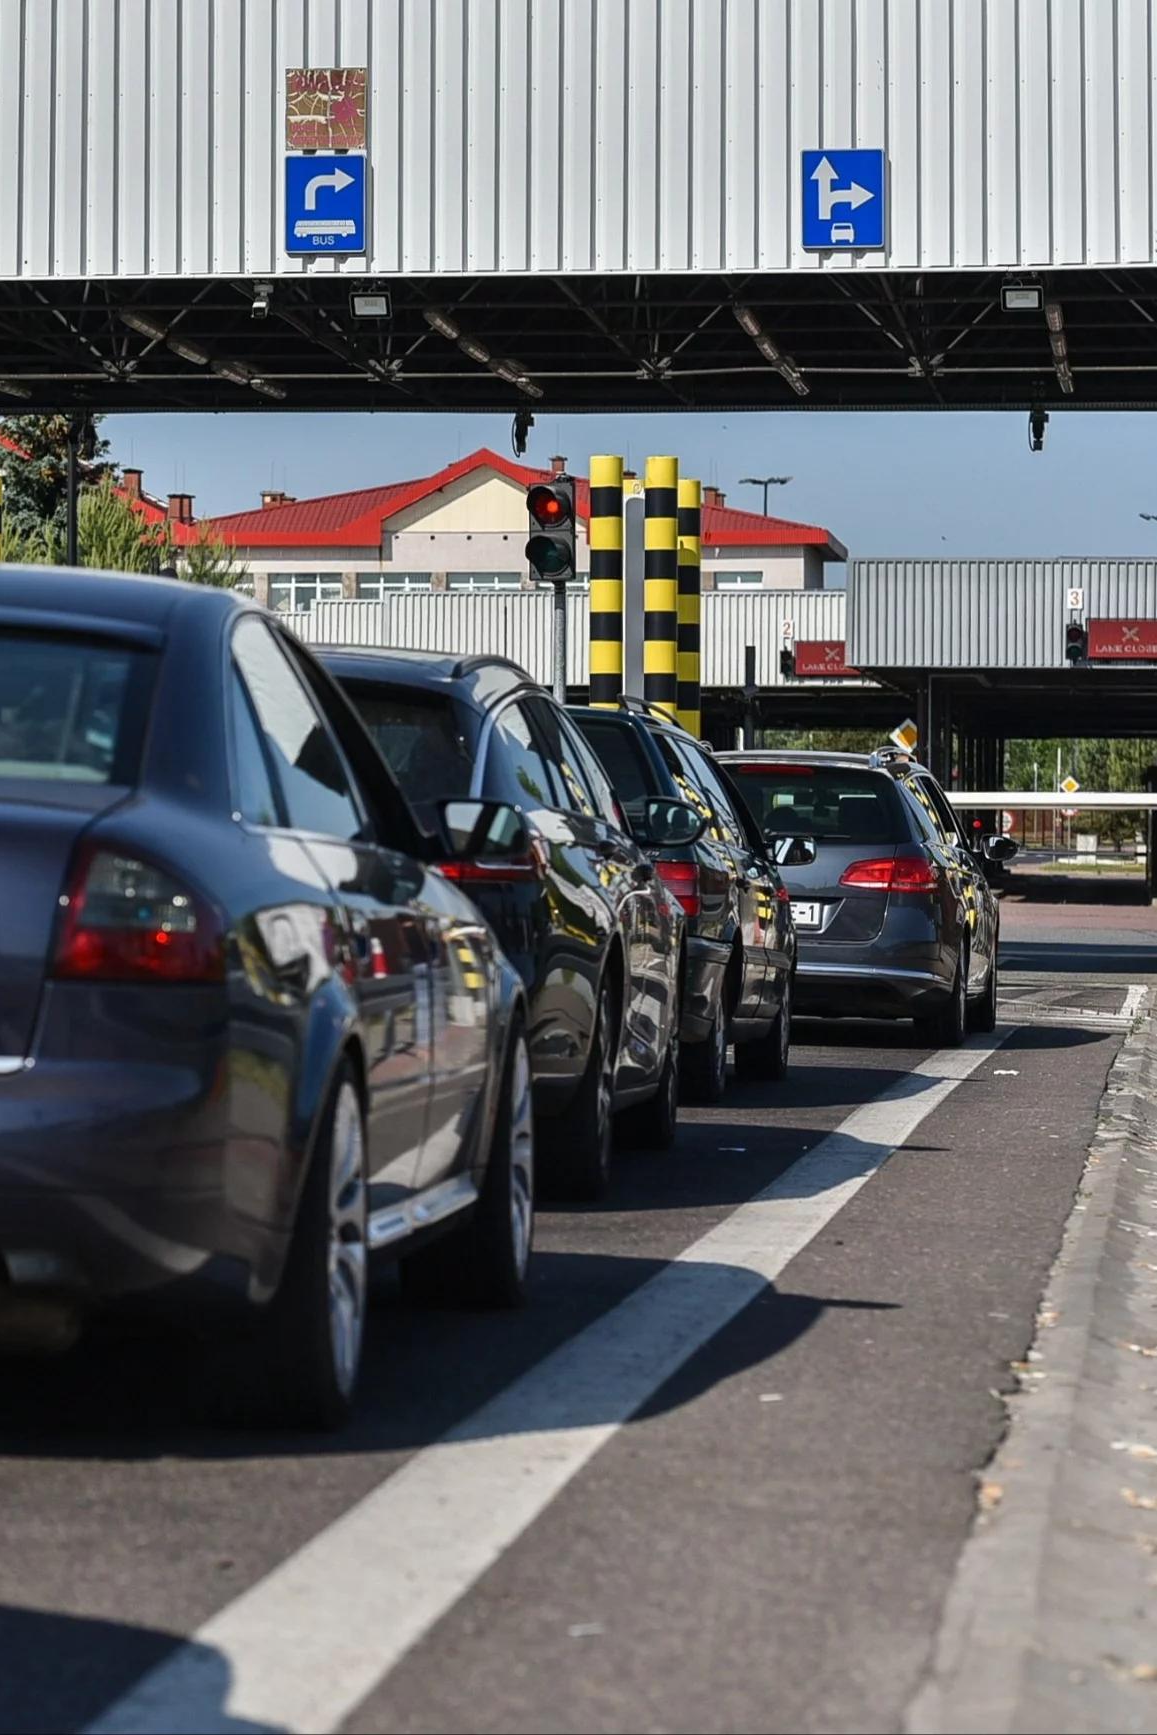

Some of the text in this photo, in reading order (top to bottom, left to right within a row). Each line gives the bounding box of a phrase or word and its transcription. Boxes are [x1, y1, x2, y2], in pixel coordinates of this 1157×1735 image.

[312, 235, 335, 246] BUS
[1070, 591, 1080, 606] 3
[782, 621, 791, 636] 2
